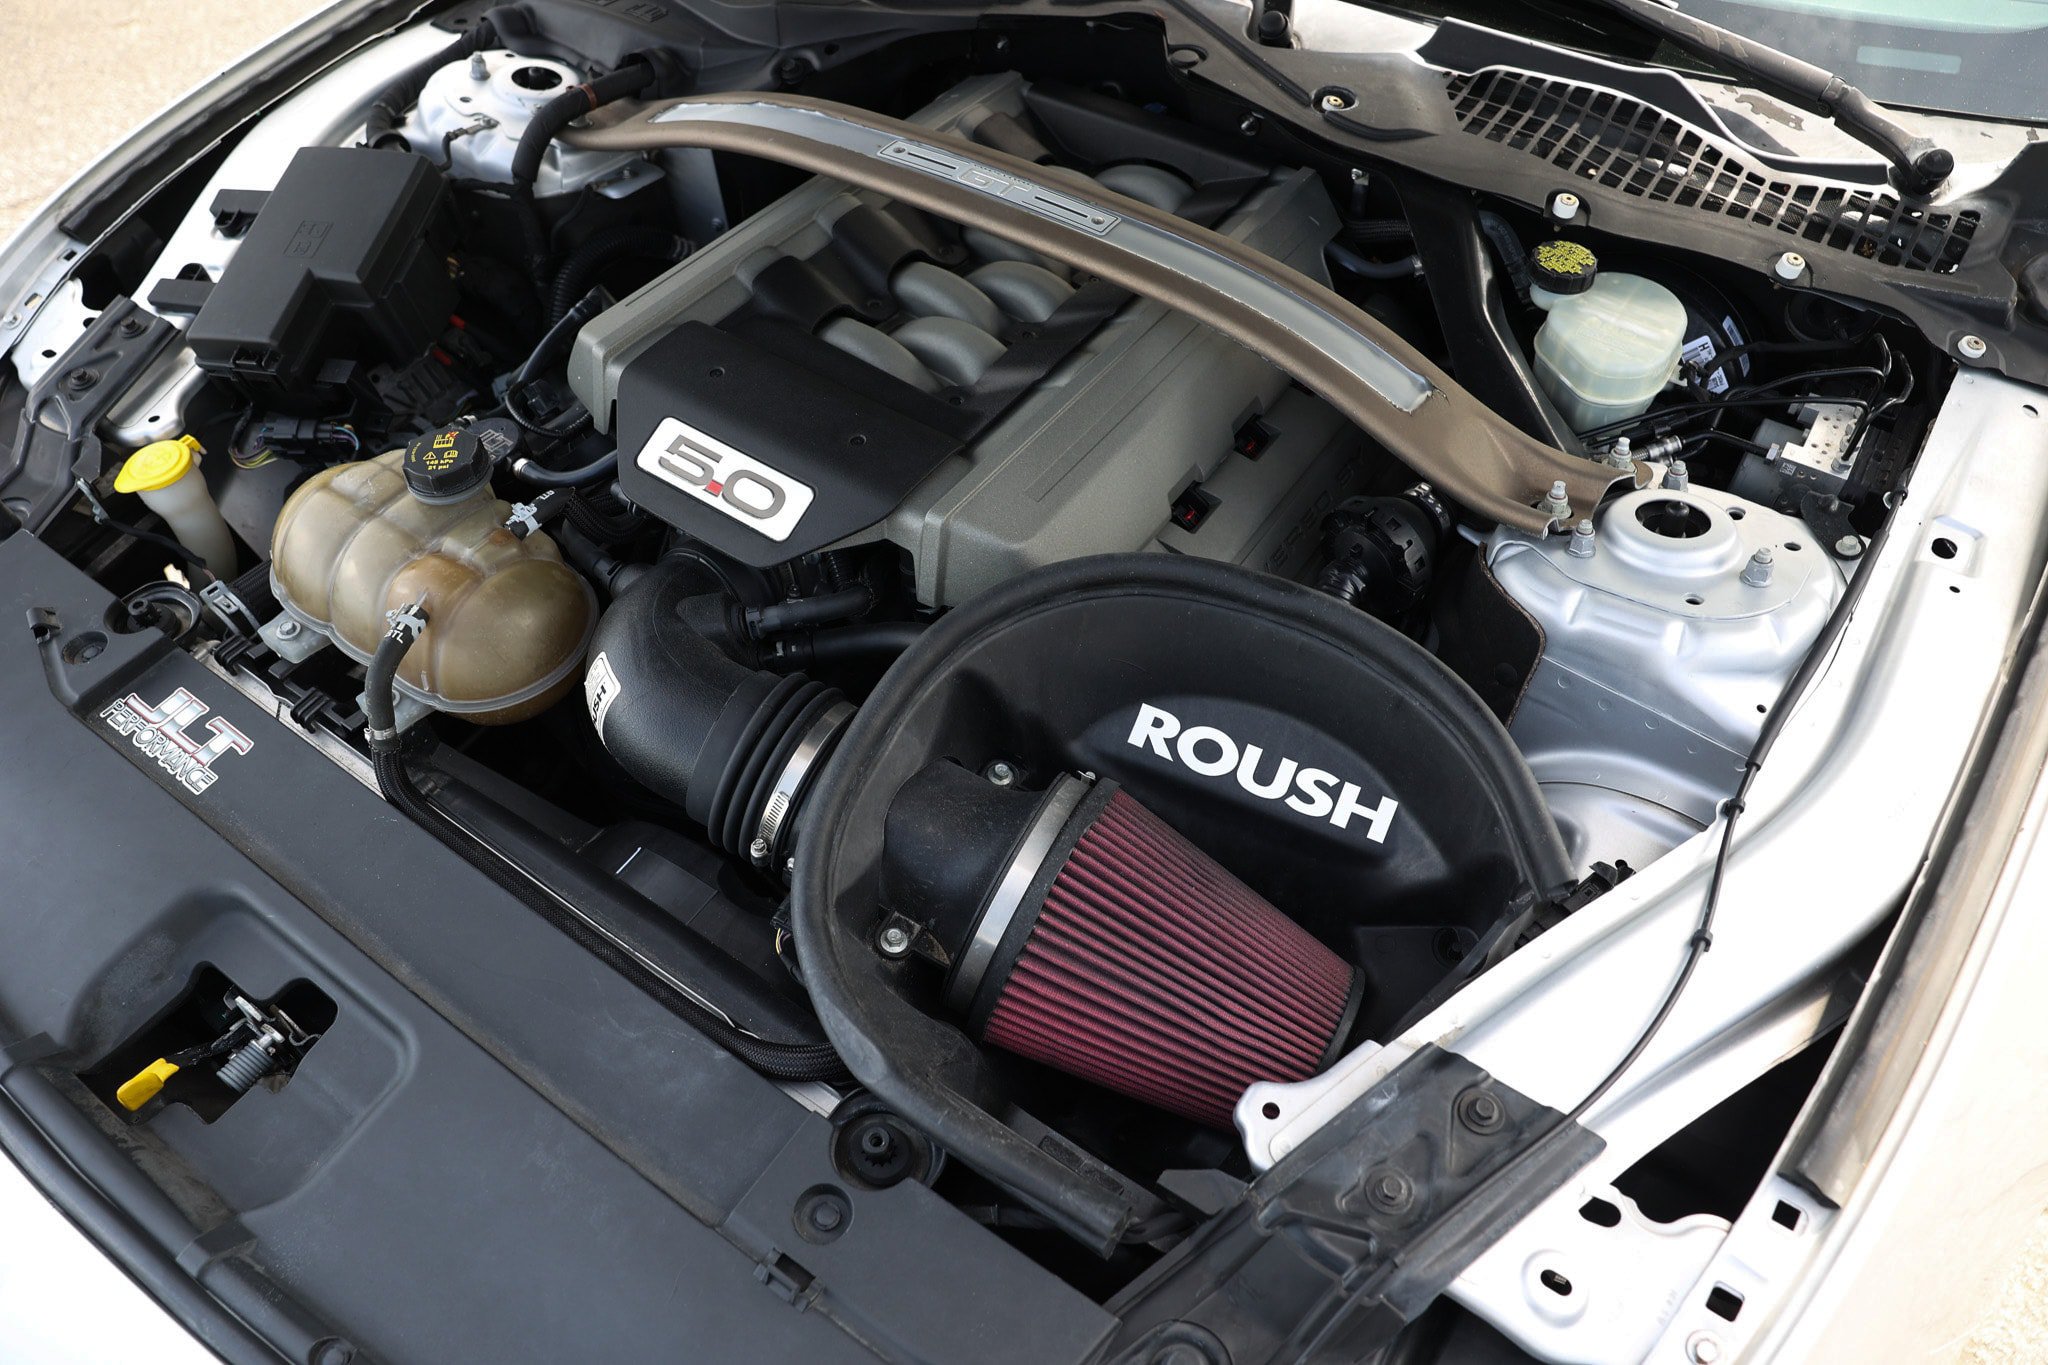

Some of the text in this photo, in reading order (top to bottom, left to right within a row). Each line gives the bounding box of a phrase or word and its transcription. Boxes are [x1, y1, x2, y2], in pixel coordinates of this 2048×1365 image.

[1698, 341, 1711, 352] H
[658, 434, 786, 519] 5.0
[124, 687, 254, 767] JLT
[592, 684, 607, 725] USH
[100, 698, 219, 795] PERFORMANCE
[1127, 702, 1399, 844] ROUSH
